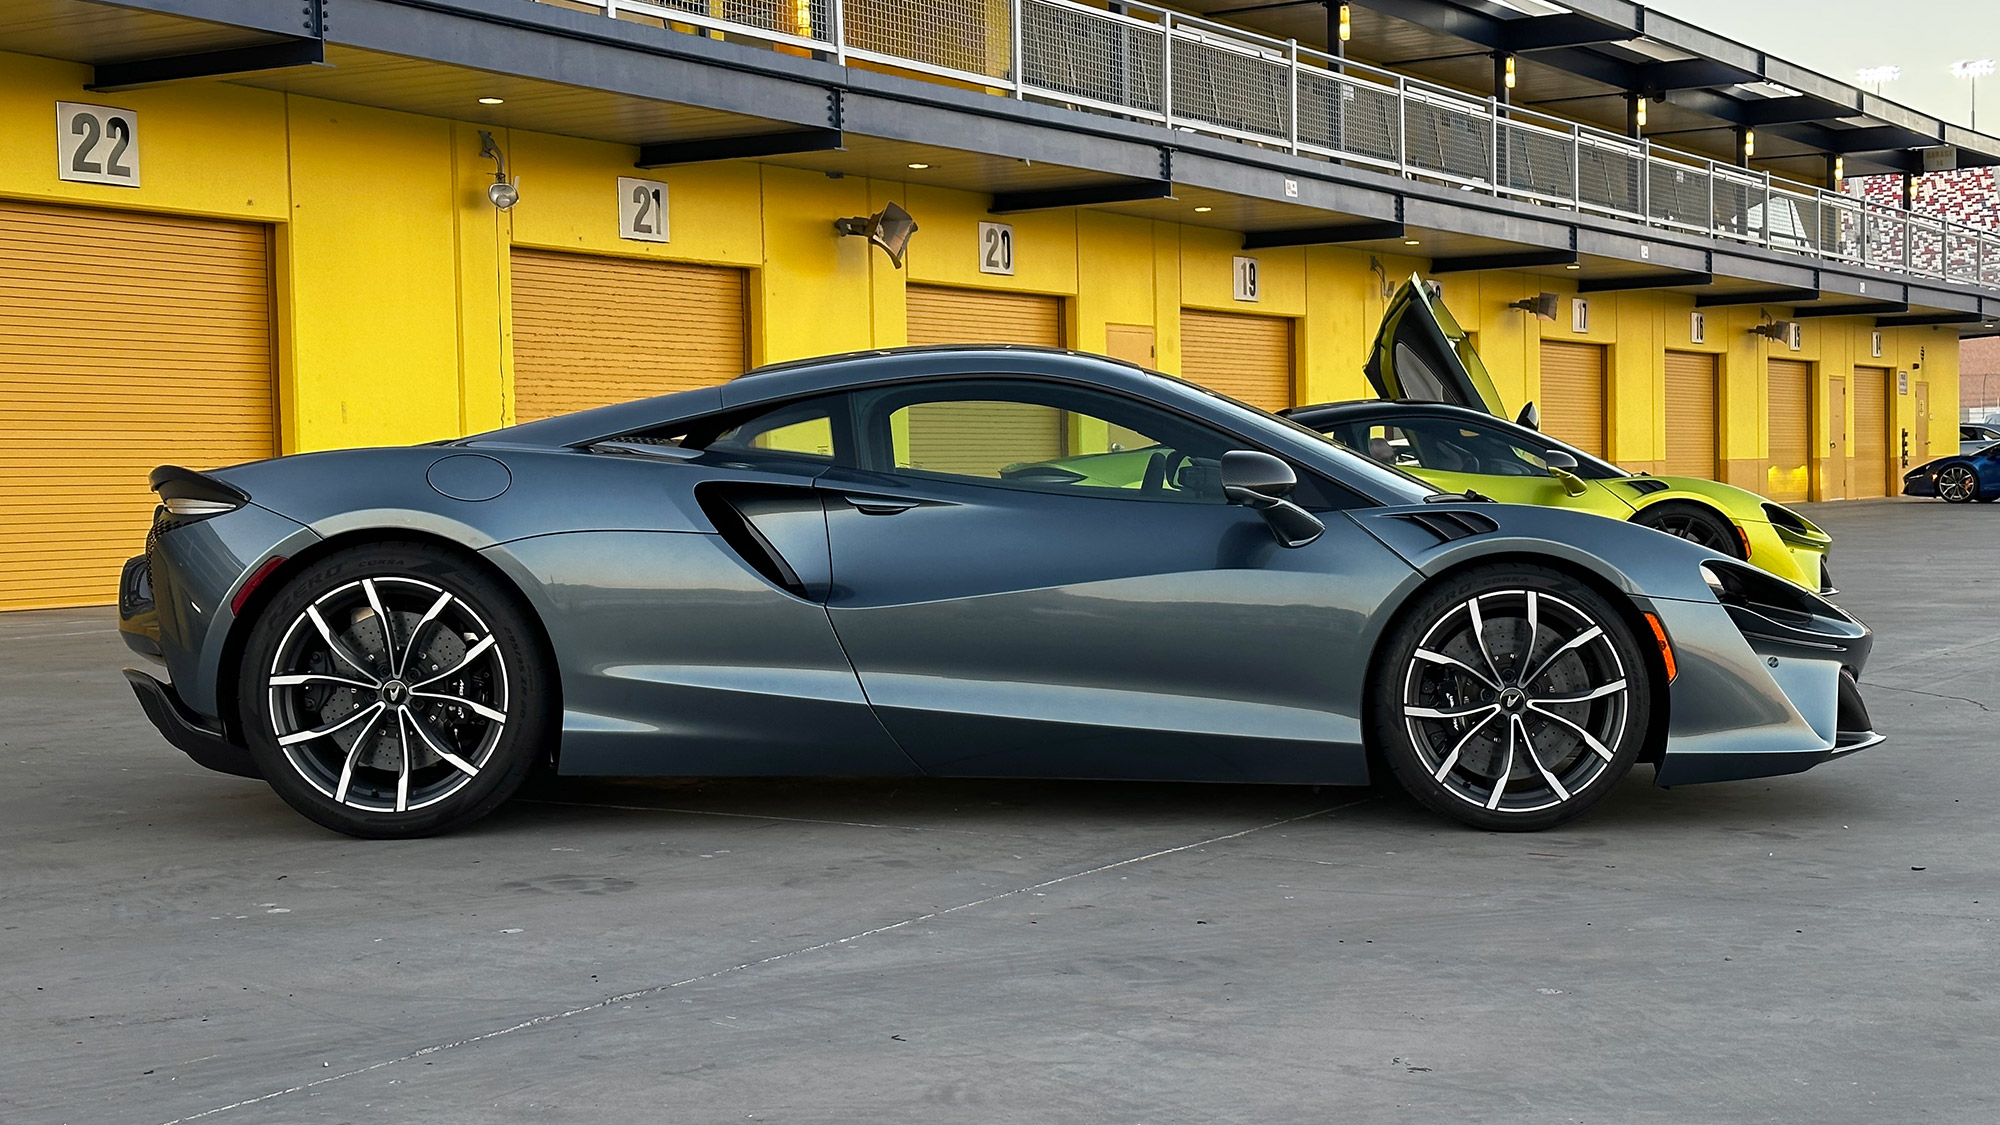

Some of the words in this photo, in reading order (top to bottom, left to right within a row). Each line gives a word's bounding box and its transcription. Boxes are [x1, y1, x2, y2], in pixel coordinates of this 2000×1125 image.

[72, 112, 131, 178] 22
[633, 185, 661, 235] 21
[985, 227, 1011, 270] 20
[1240, 262, 1256, 297] 19
[1577, 302, 1587, 329] 17
[1696, 315, 1704, 341] 16
[358, 559, 406, 567] CORSA
